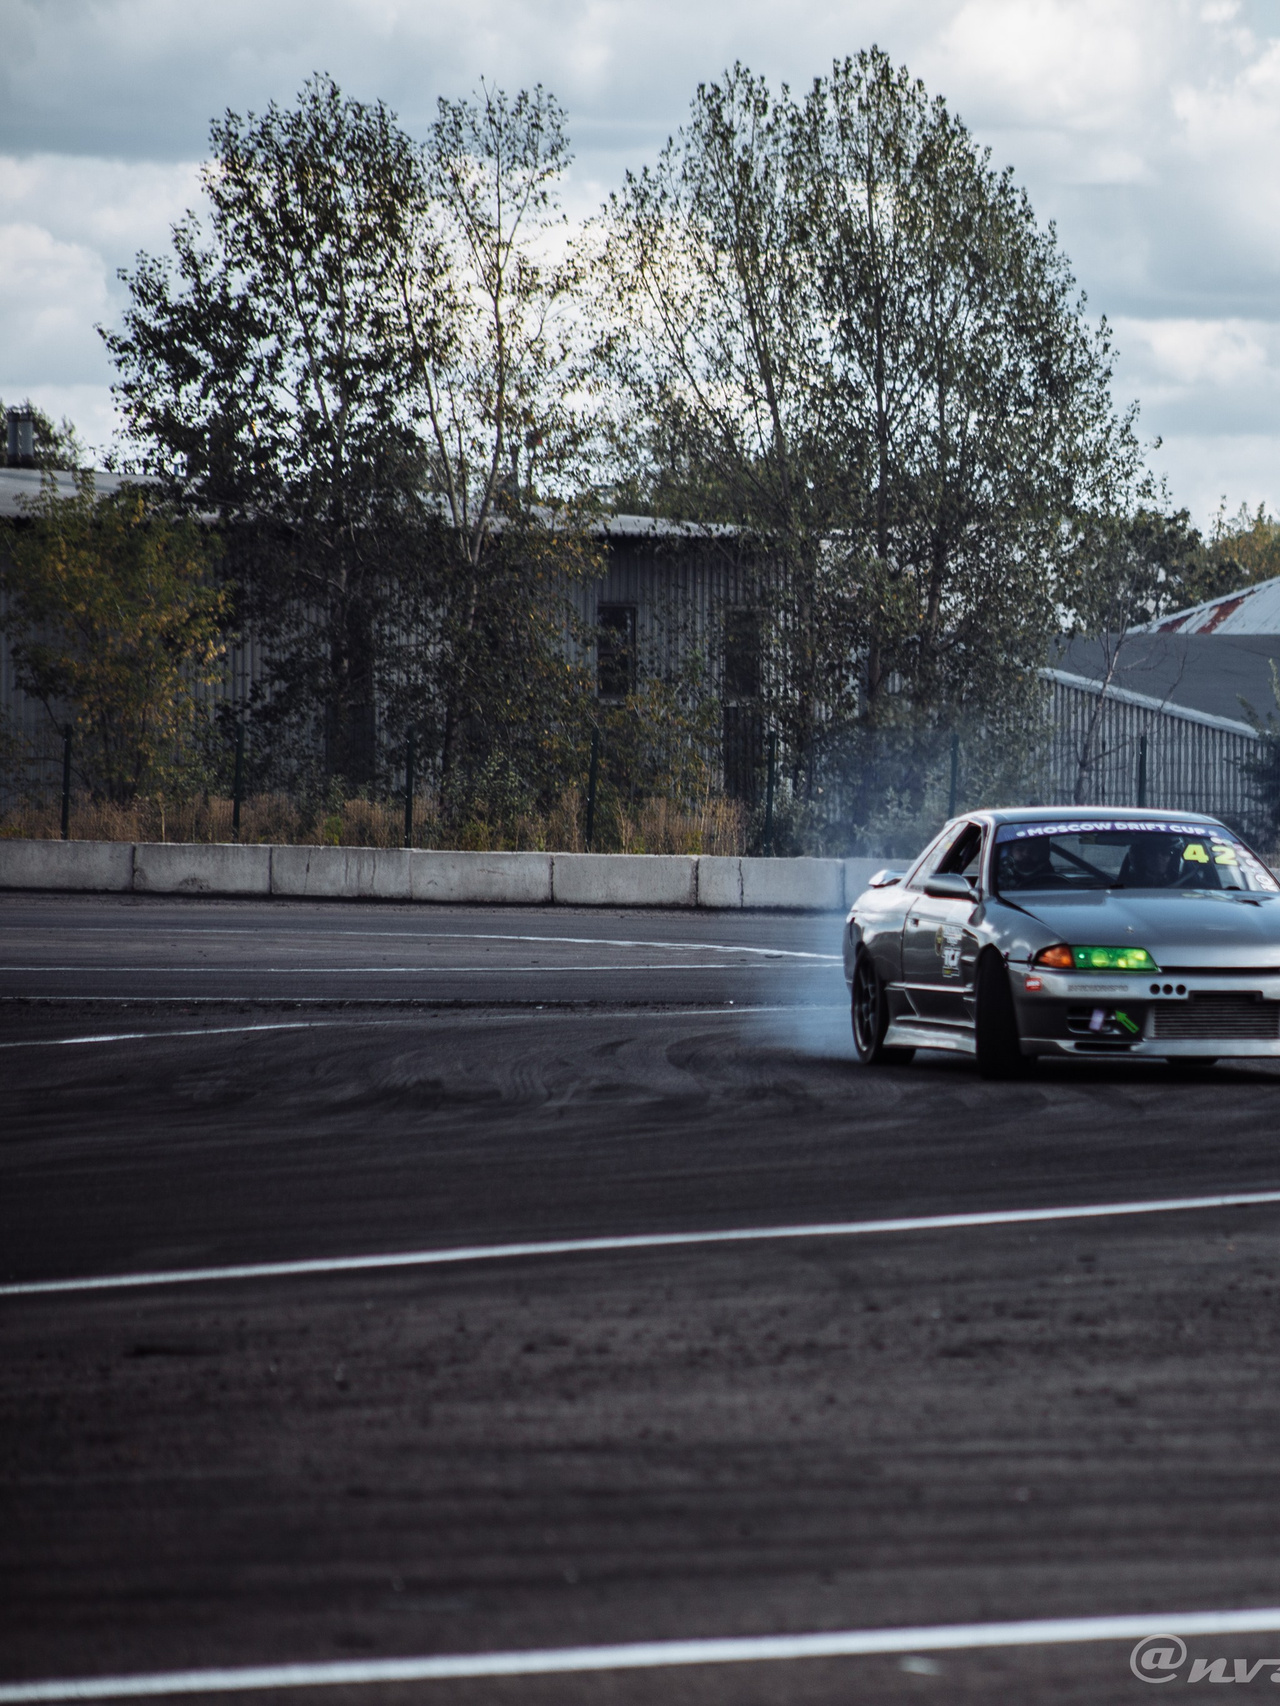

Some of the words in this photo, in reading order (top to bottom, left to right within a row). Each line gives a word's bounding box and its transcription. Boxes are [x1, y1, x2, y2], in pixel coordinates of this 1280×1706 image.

[1028, 822, 1111, 836] MOSCOW
[1114, 821, 1167, 832] DRIFT
[1169, 824, 1206, 836] CUP
[1183, 844, 1238, 866] 42
